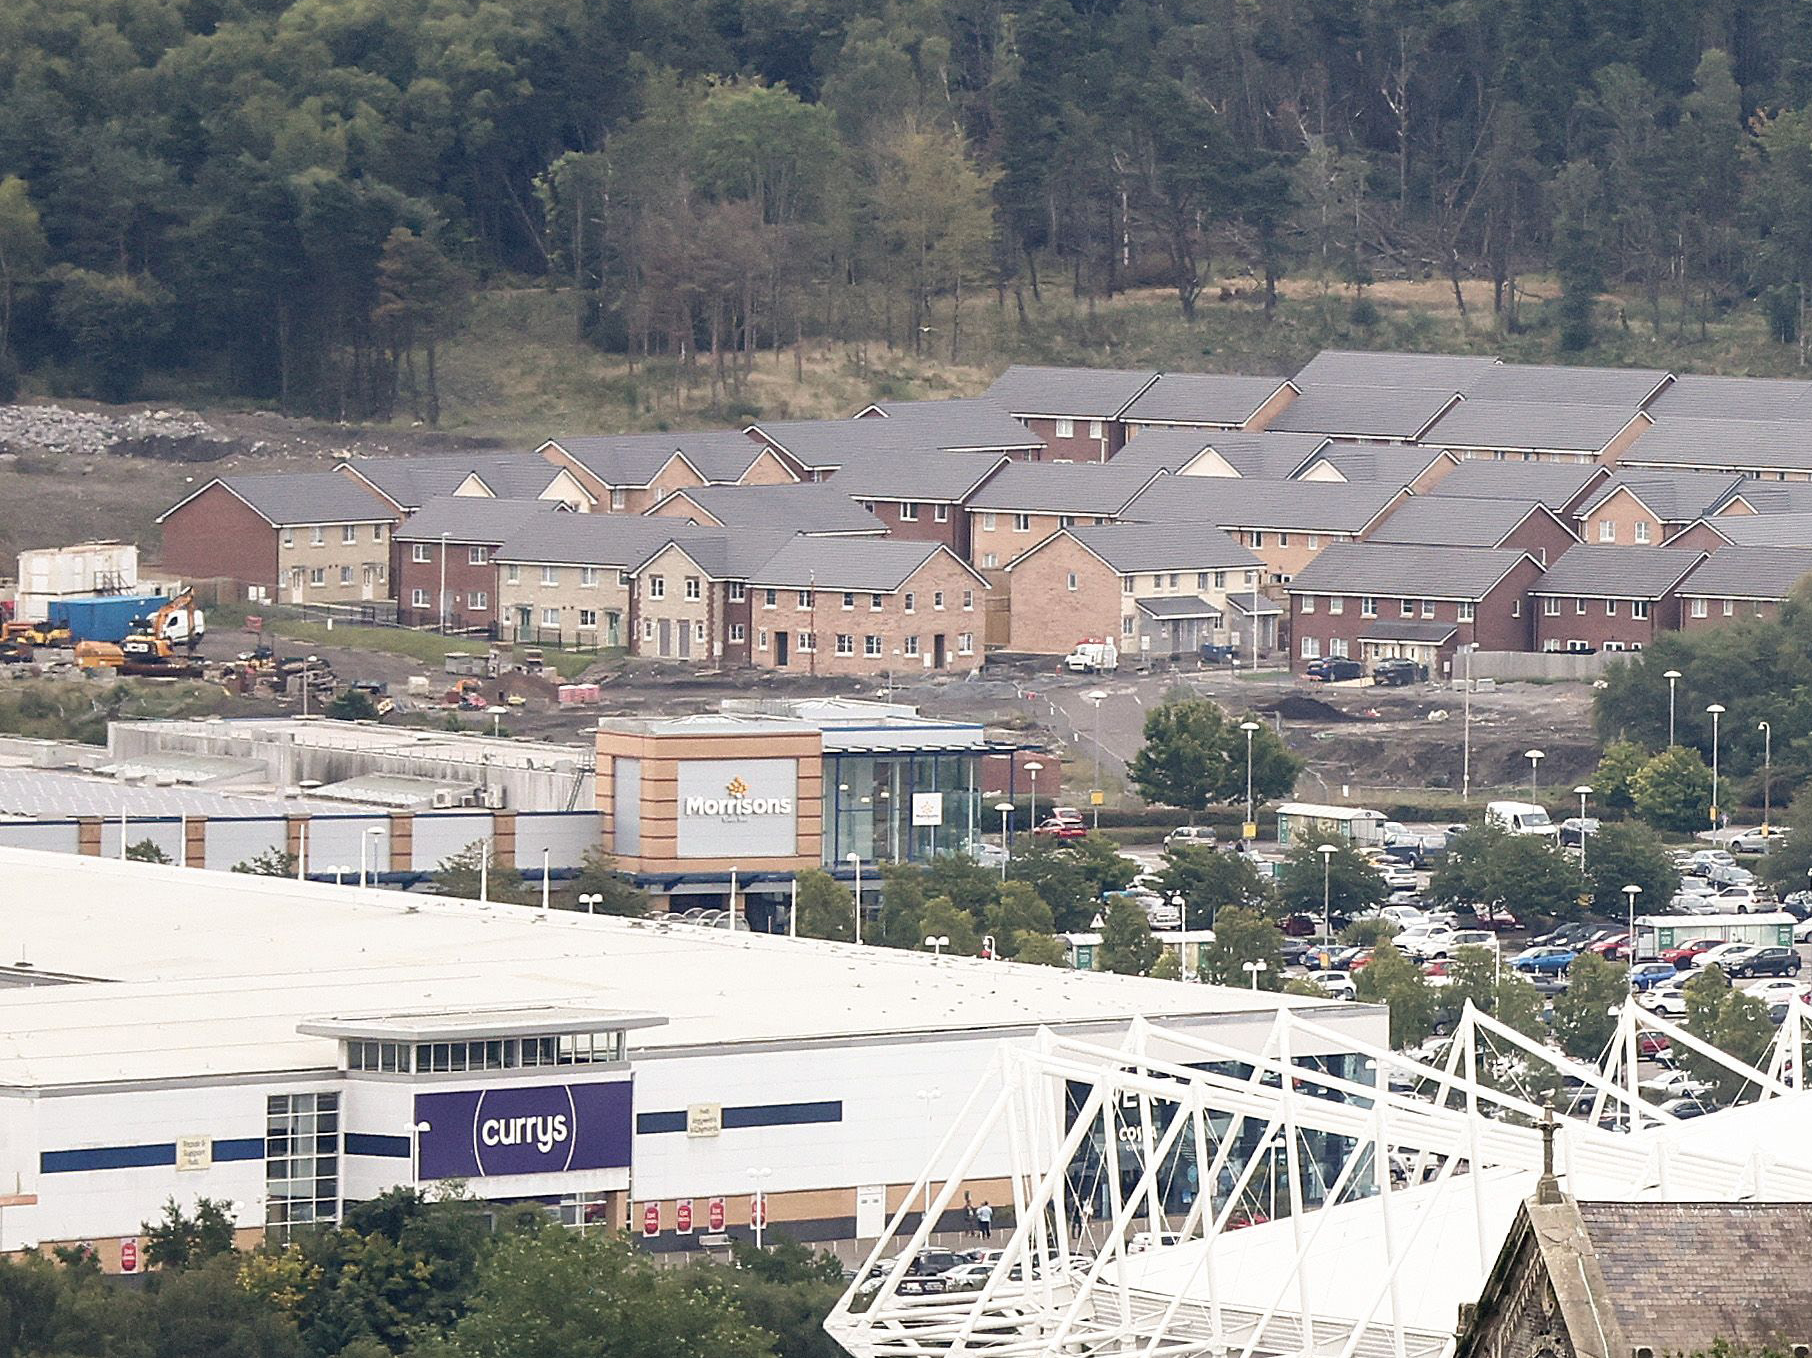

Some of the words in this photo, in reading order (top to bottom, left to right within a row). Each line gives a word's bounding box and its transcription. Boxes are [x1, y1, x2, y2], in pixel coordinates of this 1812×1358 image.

[124, 643, 149, 653] JCB
[685, 796, 792, 816] Morrisons
[482, 1114, 567, 1153] currys
